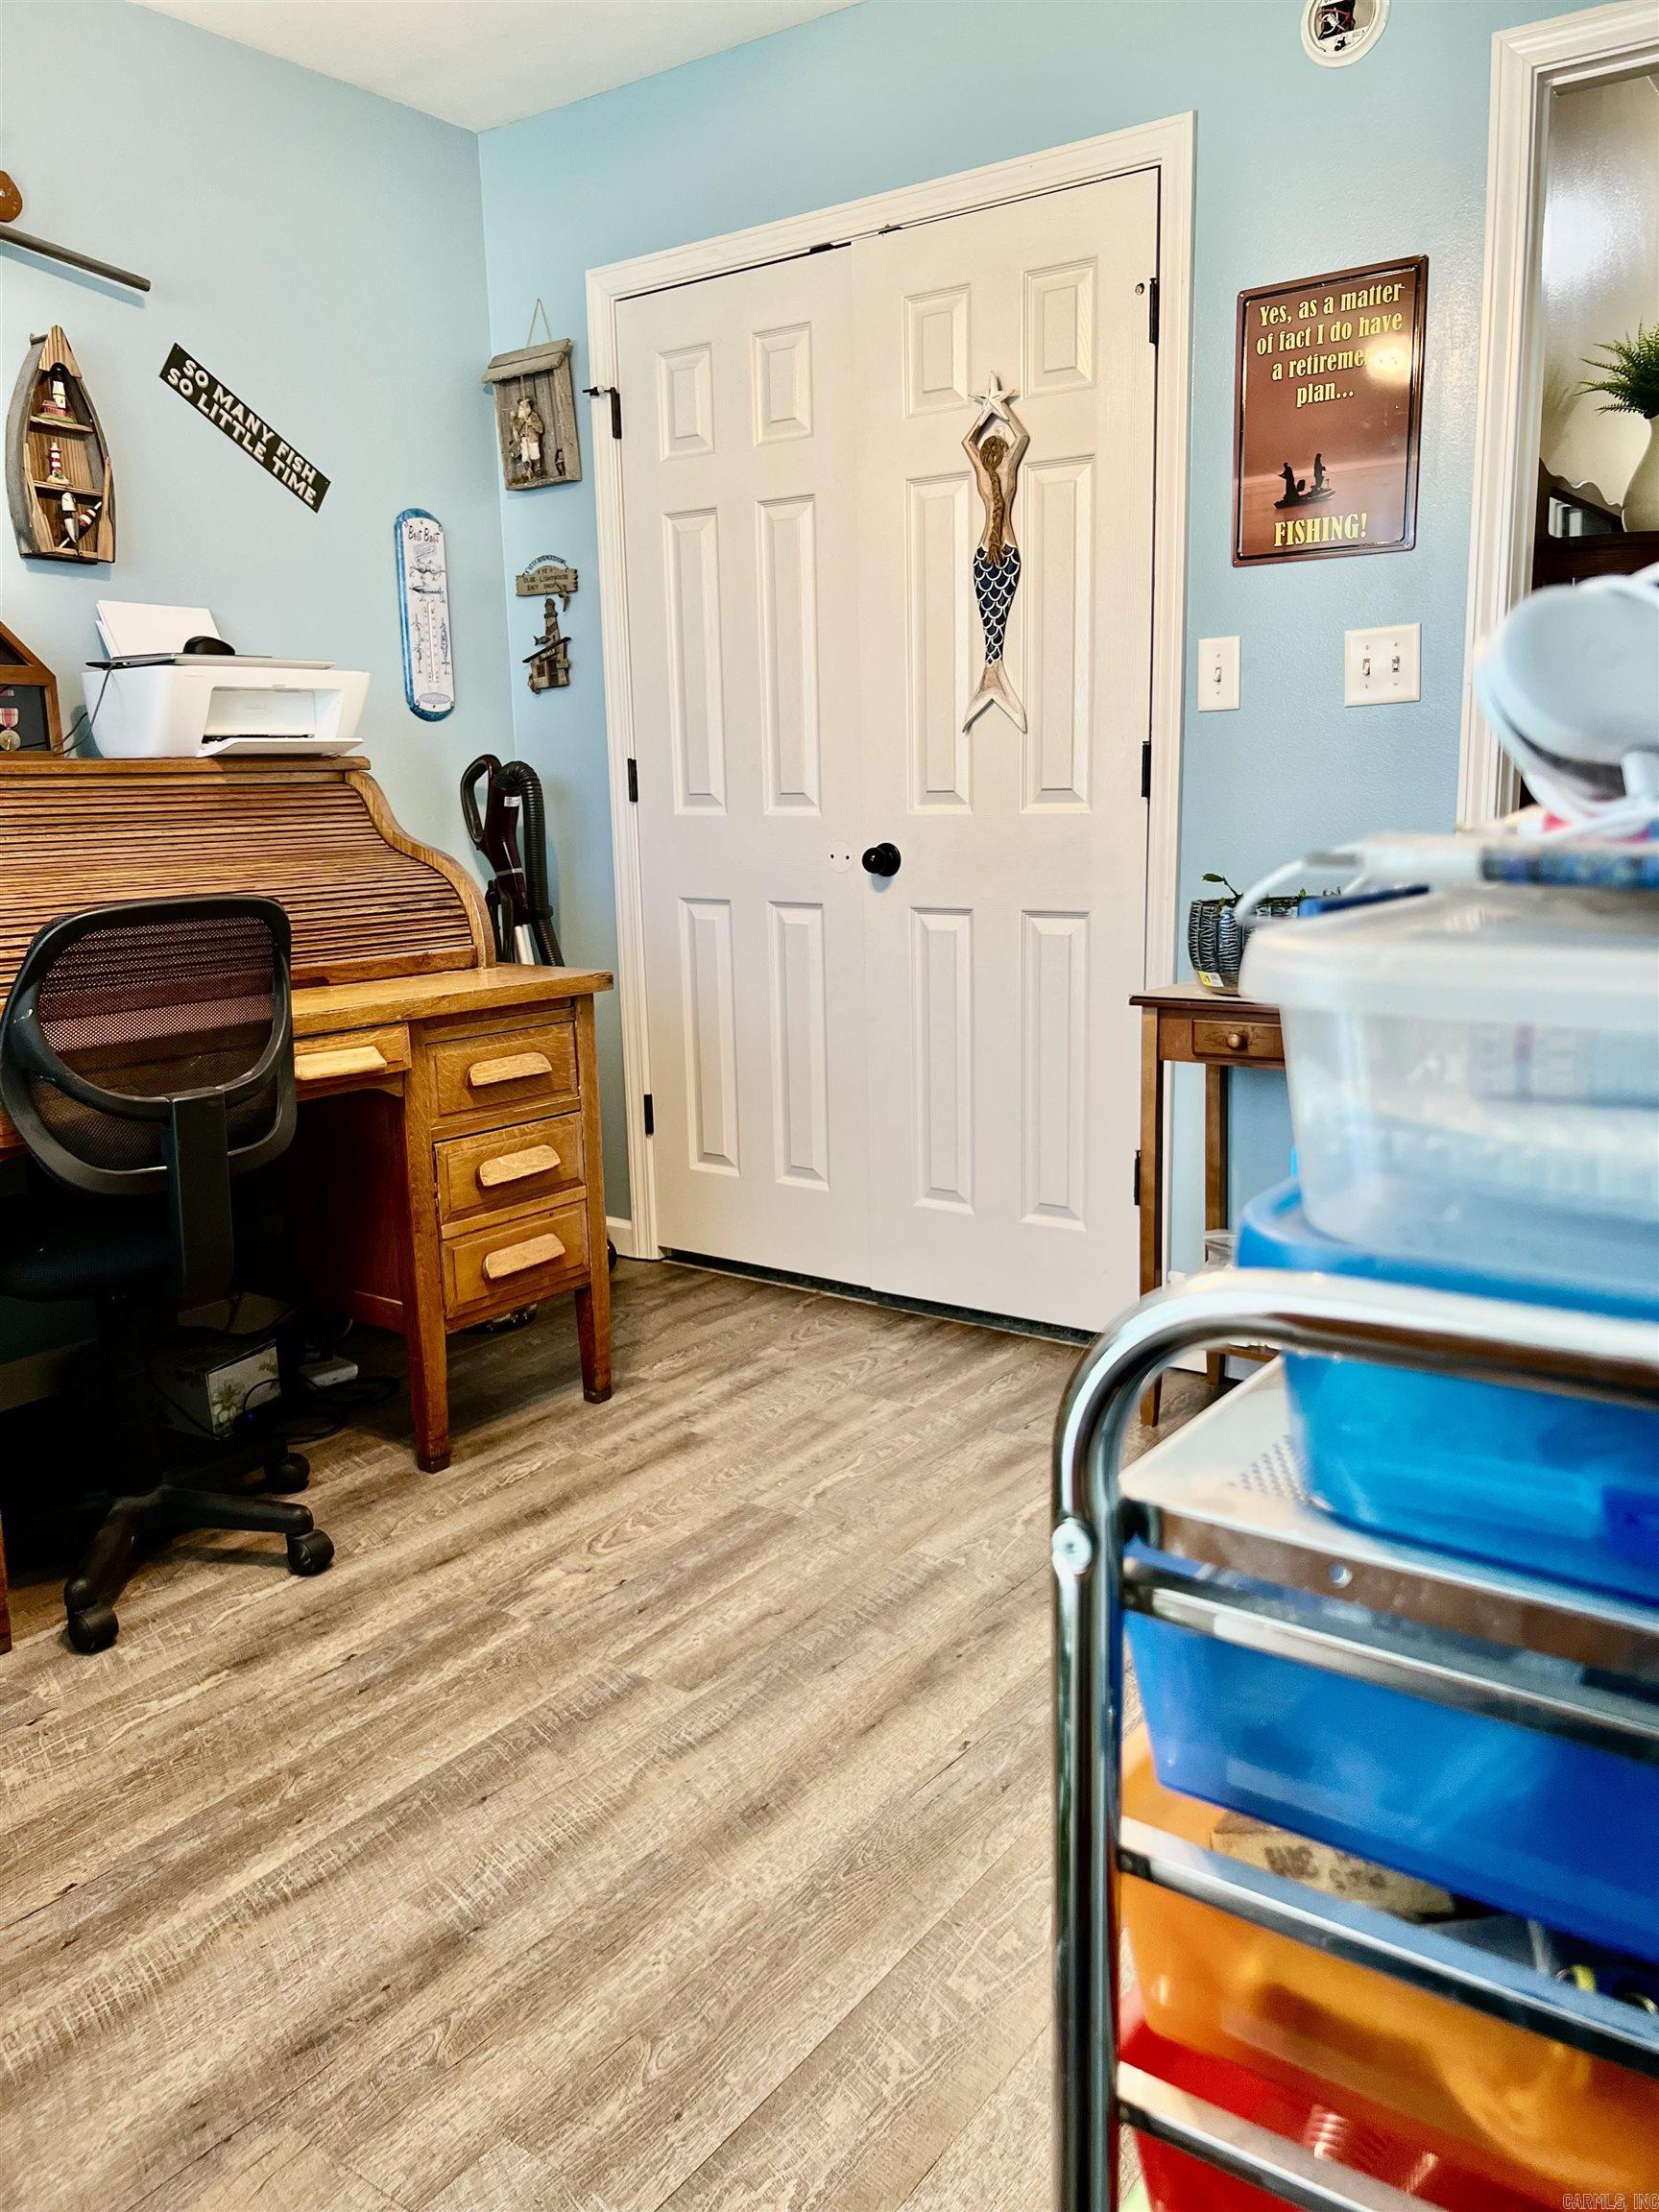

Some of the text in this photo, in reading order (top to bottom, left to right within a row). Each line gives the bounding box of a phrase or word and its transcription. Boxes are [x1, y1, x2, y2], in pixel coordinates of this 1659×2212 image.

[1260, 282, 1405, 326] Yes, as a matter
[1256, 312, 1403, 355] of fact I do have
[1272, 346, 1390, 381] a retireme
[1296, 382, 1354, 408] plan...
[167, 368, 317, 505] SO LITTLE TIME
[182, 359, 318, 485] SO MANY FISH
[1273, 512, 1368, 547] FISHING!
